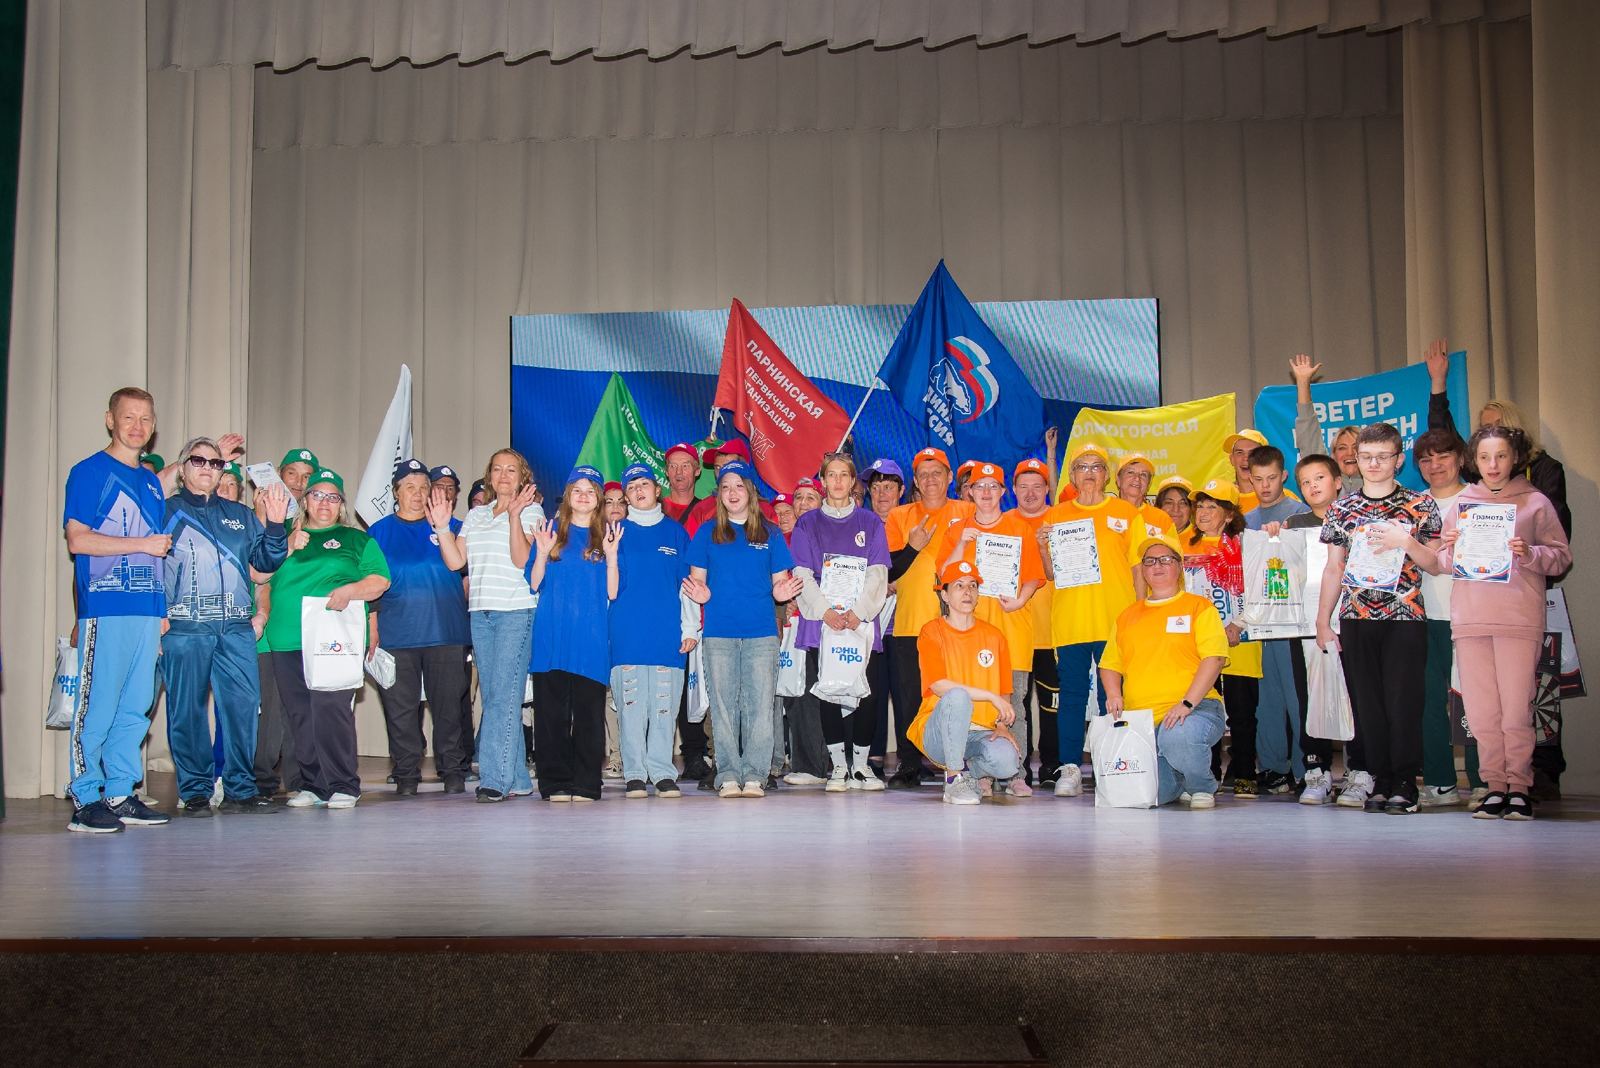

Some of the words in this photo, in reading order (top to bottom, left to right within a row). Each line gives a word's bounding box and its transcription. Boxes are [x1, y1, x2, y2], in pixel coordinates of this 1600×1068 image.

[746, 339, 824, 420] ПАРНИНСКАЯ
[745, 366, 797, 421] ПЕРВИЧНАЯ
[1312, 392, 1395, 423] ВЕТЕР
[1472, 513, 1504, 521] Грамота
[1057, 527, 1086, 537] Грамота
[985, 539, 1013, 550] Грамота
[833, 562, 858, 570] Грамота
[839, 653, 863, 664] про
